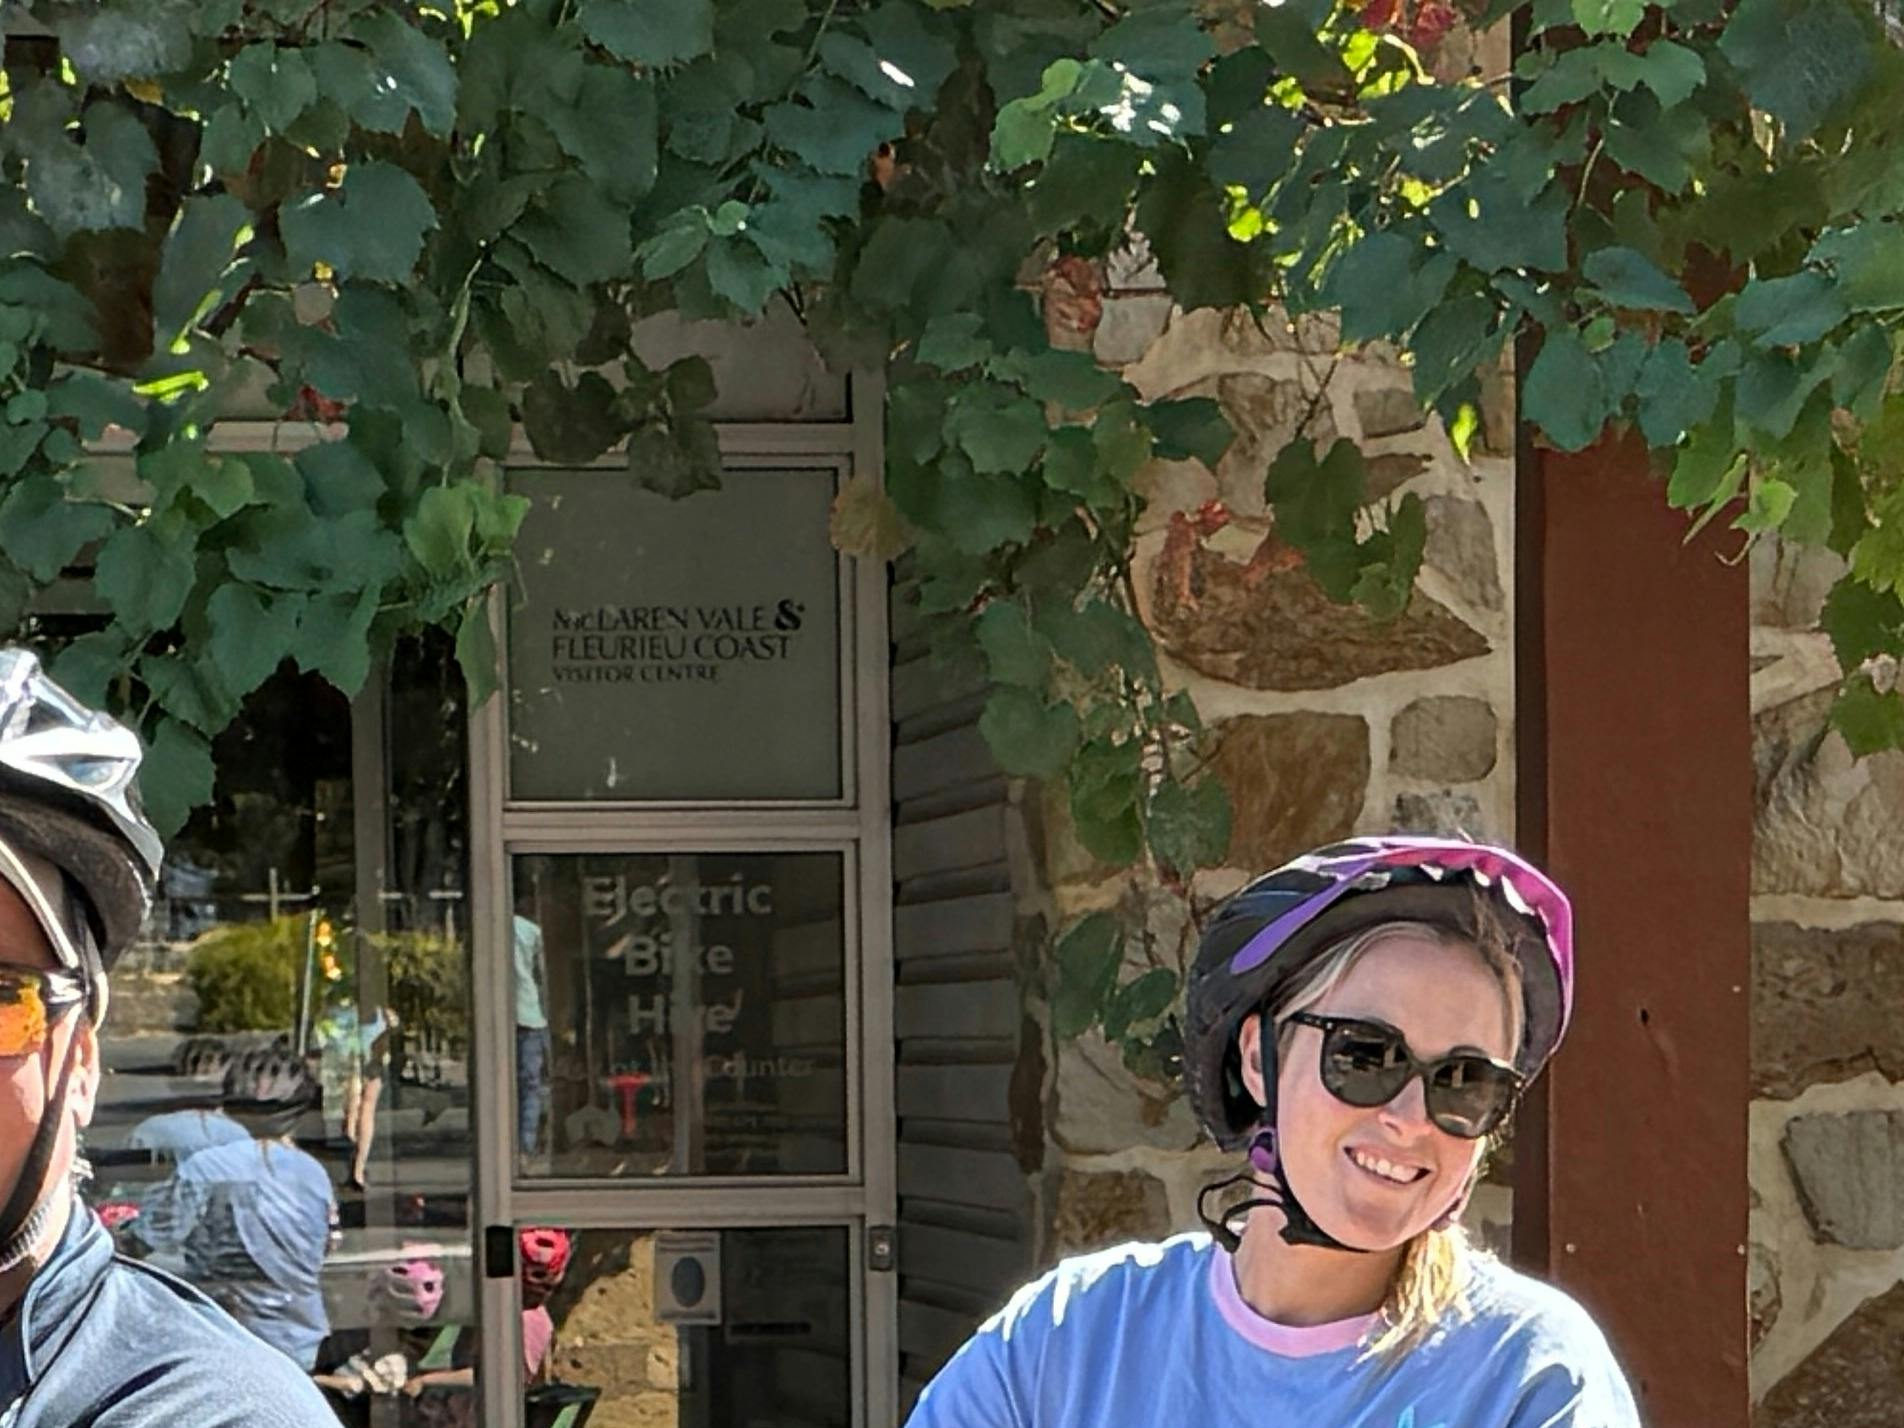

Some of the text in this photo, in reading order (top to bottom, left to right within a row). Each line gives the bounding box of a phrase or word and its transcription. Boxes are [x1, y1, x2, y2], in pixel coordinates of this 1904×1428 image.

[553, 599, 805, 632] McLAREN VALE &
[552, 635, 791, 660] FLEURIEU COAST
[552, 665, 719, 682] VISITOR CENTRE
